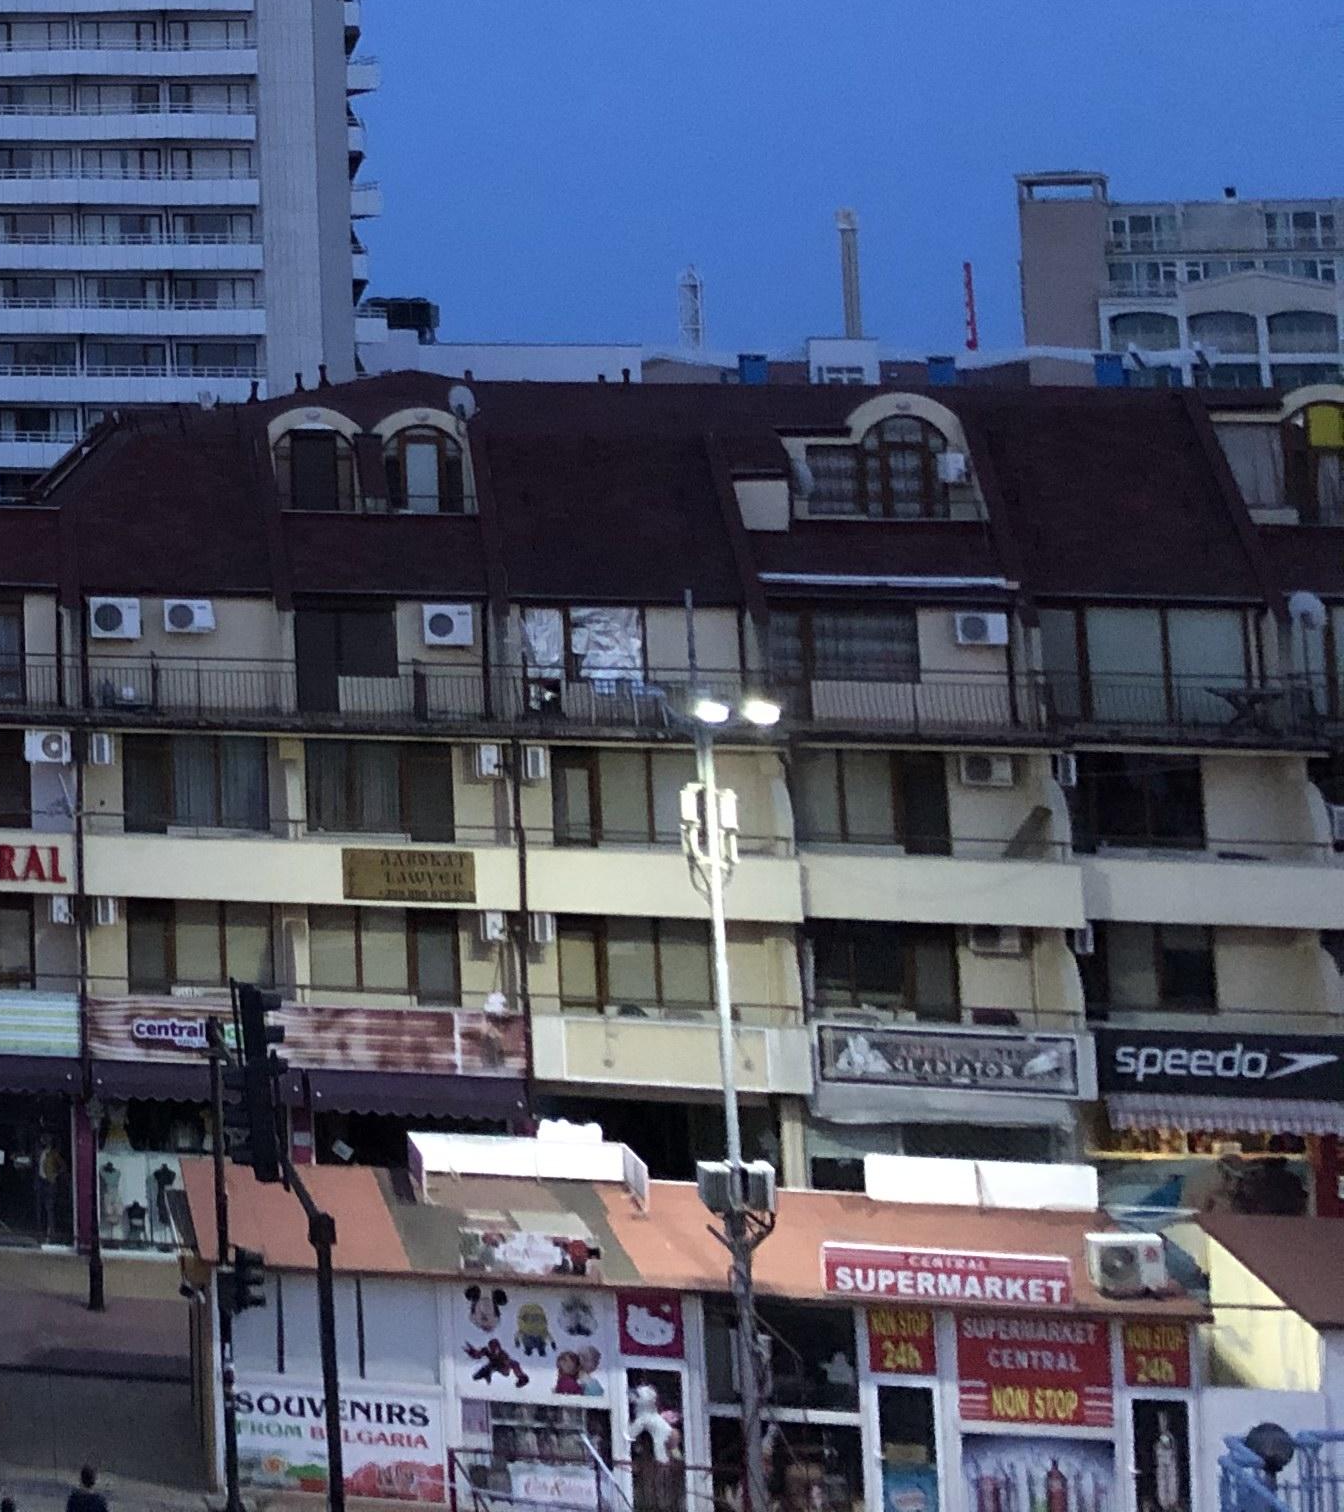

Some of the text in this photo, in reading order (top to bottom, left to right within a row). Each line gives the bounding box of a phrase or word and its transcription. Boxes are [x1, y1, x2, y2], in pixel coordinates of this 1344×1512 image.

[135, 1020, 205, 1038] central
[1115, 1042, 1269, 1082] speedo
[909, 1254, 988, 1272] CENTRAL
[834, 1266, 1066, 1304] SUPERMARKET
[962, 1317, 1097, 1345] SUPERMARKET
[881, 1339, 923, 1369] 24h
[987, 1348, 1082, 1373] CENTRAL
[991, 1386, 1079, 1420] NON STOP
[309, 1424, 430, 1450] BLGARIA
